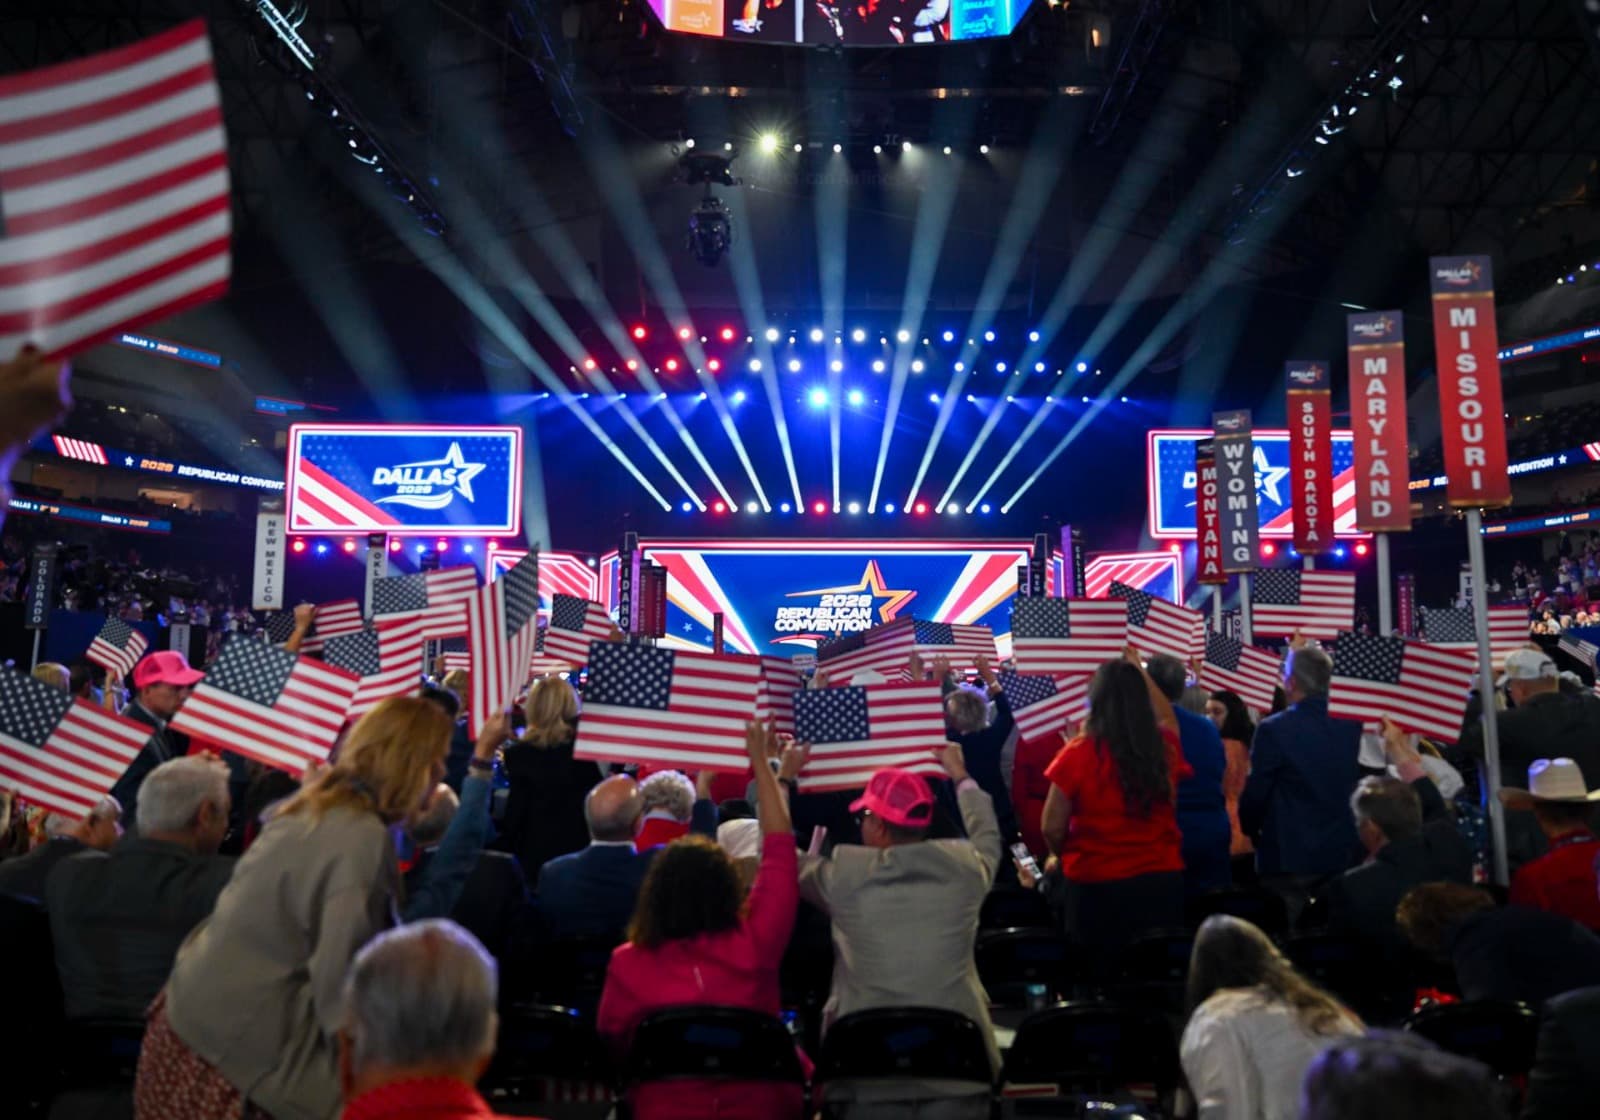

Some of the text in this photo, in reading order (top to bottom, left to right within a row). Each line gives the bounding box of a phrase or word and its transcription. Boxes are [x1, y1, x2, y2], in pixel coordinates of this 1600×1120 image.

[1450, 308, 1485, 490] MISSOURI
[1363, 357, 1392, 518] MARYLAND
[177, 465, 239, 484] REPUBLICAN
[240, 475, 286, 490] CONVENT
[372, 467, 457, 485] DALLAS
[1302, 401, 1319, 541] SOUTH DAKOTA
[1507, 456, 1554, 475] NVENTION
[1202, 467, 1218, 575] MONTANA
[1222, 443, 1250, 563] WYOMING
[266, 520, 276, 545] NEW
[32, 560, 48, 623] COLORADO
[264, 551, 275, 602] MEXICO
[1464, 575, 1473, 607] TEX
[621, 568, 630, 628] IDAHO
[776, 607, 872, 620] REPUBLICAN
[820, 595, 872, 607] 2026
[774, 619, 872, 632] CONVENTION
